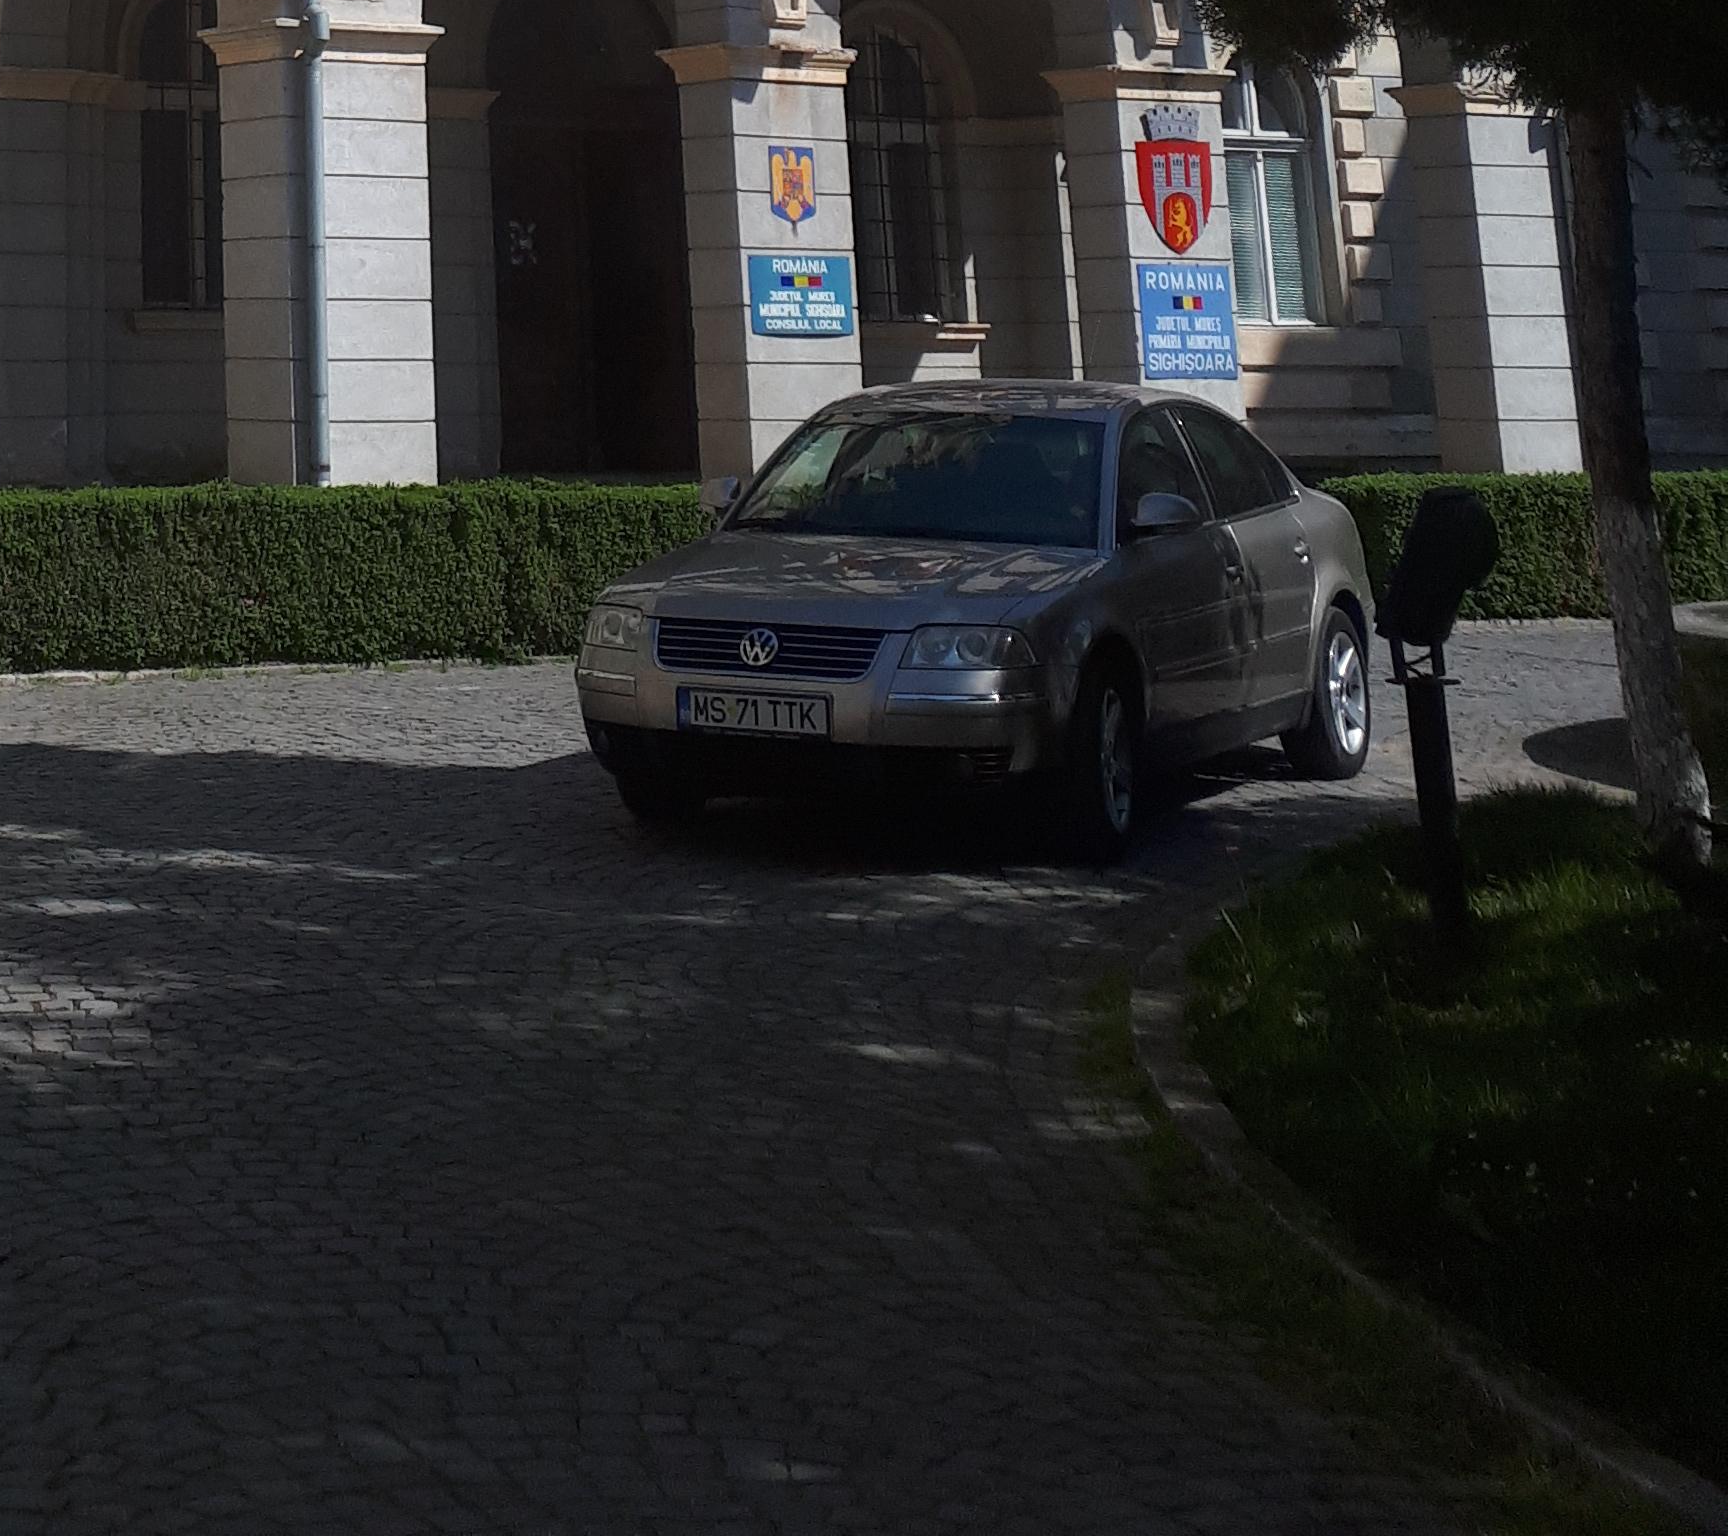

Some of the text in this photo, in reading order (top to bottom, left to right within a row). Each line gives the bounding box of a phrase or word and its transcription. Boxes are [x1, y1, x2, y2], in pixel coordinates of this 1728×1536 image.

[772, 257, 828, 274] ROMÂNIA
[1145, 269, 1225, 291] ROMÂNIA
[765, 319, 843, 330] CONSILIUL LOCAL
[740, 628, 779, 666] VW
[694, 694, 727, 723] MS
[736, 698, 759, 726] 71
[768, 700, 817, 729] TTK
